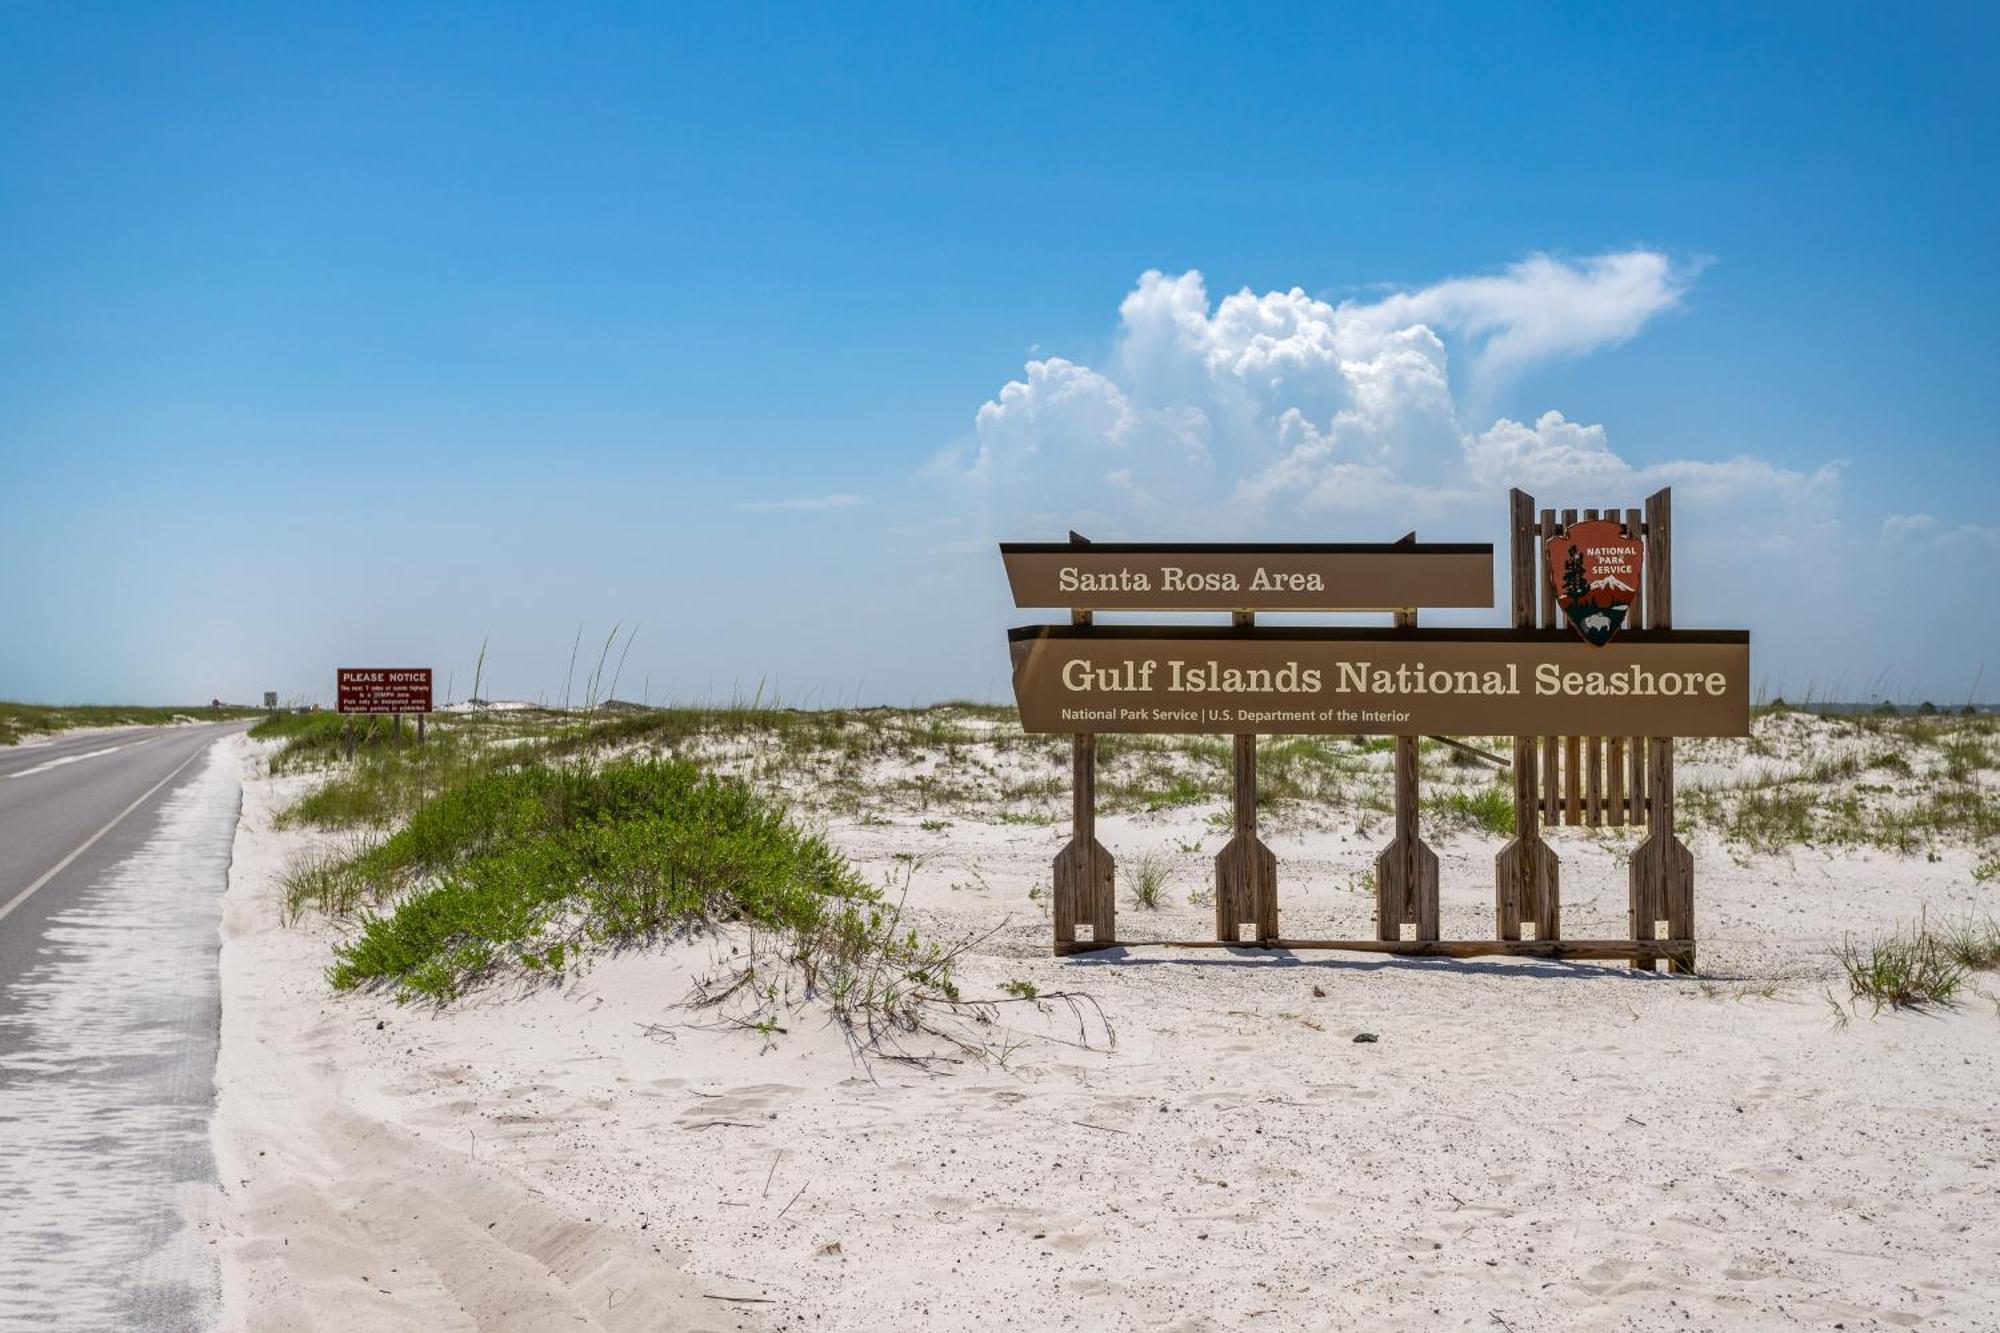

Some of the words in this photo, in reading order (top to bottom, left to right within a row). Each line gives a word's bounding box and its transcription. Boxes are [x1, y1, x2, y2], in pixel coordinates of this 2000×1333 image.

[1587, 547, 1637, 556] NATIONAL
[1599, 556, 1625, 565] PARK
[1591, 565, 1633, 575] SERVICE
[1058, 566, 1151, 592] Santa
[1161, 567, 1240, 592] Rosa
[1249, 567, 1325, 592] Area
[343, 673, 384, 682] PLEASE
[389, 673, 427, 682] NOTICE
[1062, 658, 1157, 693] Gulf
[1167, 660, 1322, 694] Islands
[1335, 661, 1521, 695] National
[1535, 662, 1727, 697] Seashore
[1061, 707, 1117, 720] National
[1120, 708, 1149, 720] Park
[1153, 708, 1198, 721] Service
[1209, 709, 1234, 721] U.S.
[1238, 709, 1316, 724] Department
[1319, 709, 1334, 721] of
[1337, 709, 1359, 722] the
[1361, 709, 1411, 722] Interior
